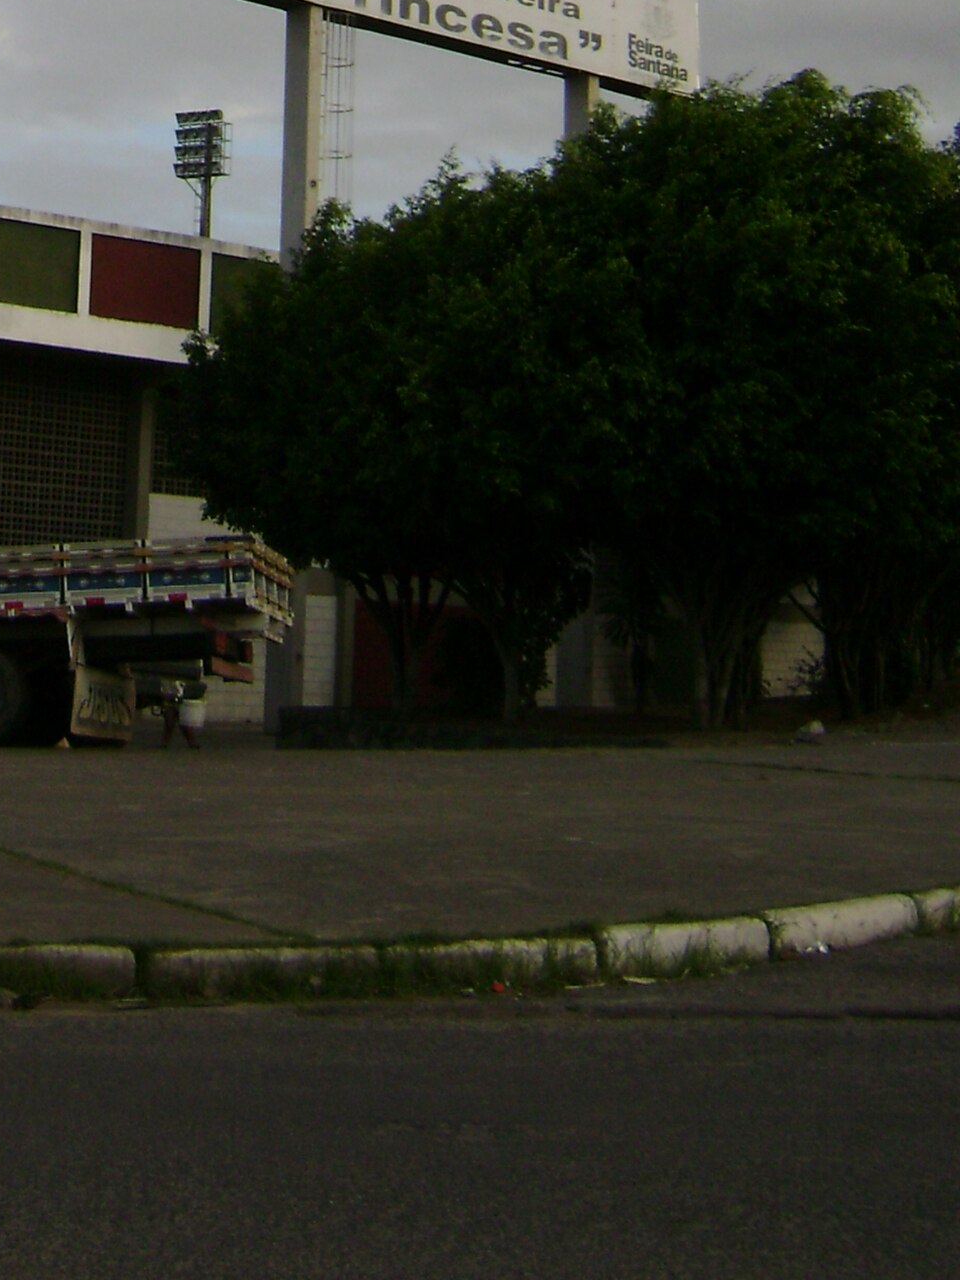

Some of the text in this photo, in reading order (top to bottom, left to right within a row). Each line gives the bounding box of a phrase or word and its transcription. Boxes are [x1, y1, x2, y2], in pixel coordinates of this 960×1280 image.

[628, 32, 679, 63] Feira de
[628, 50, 688, 82] Santana
